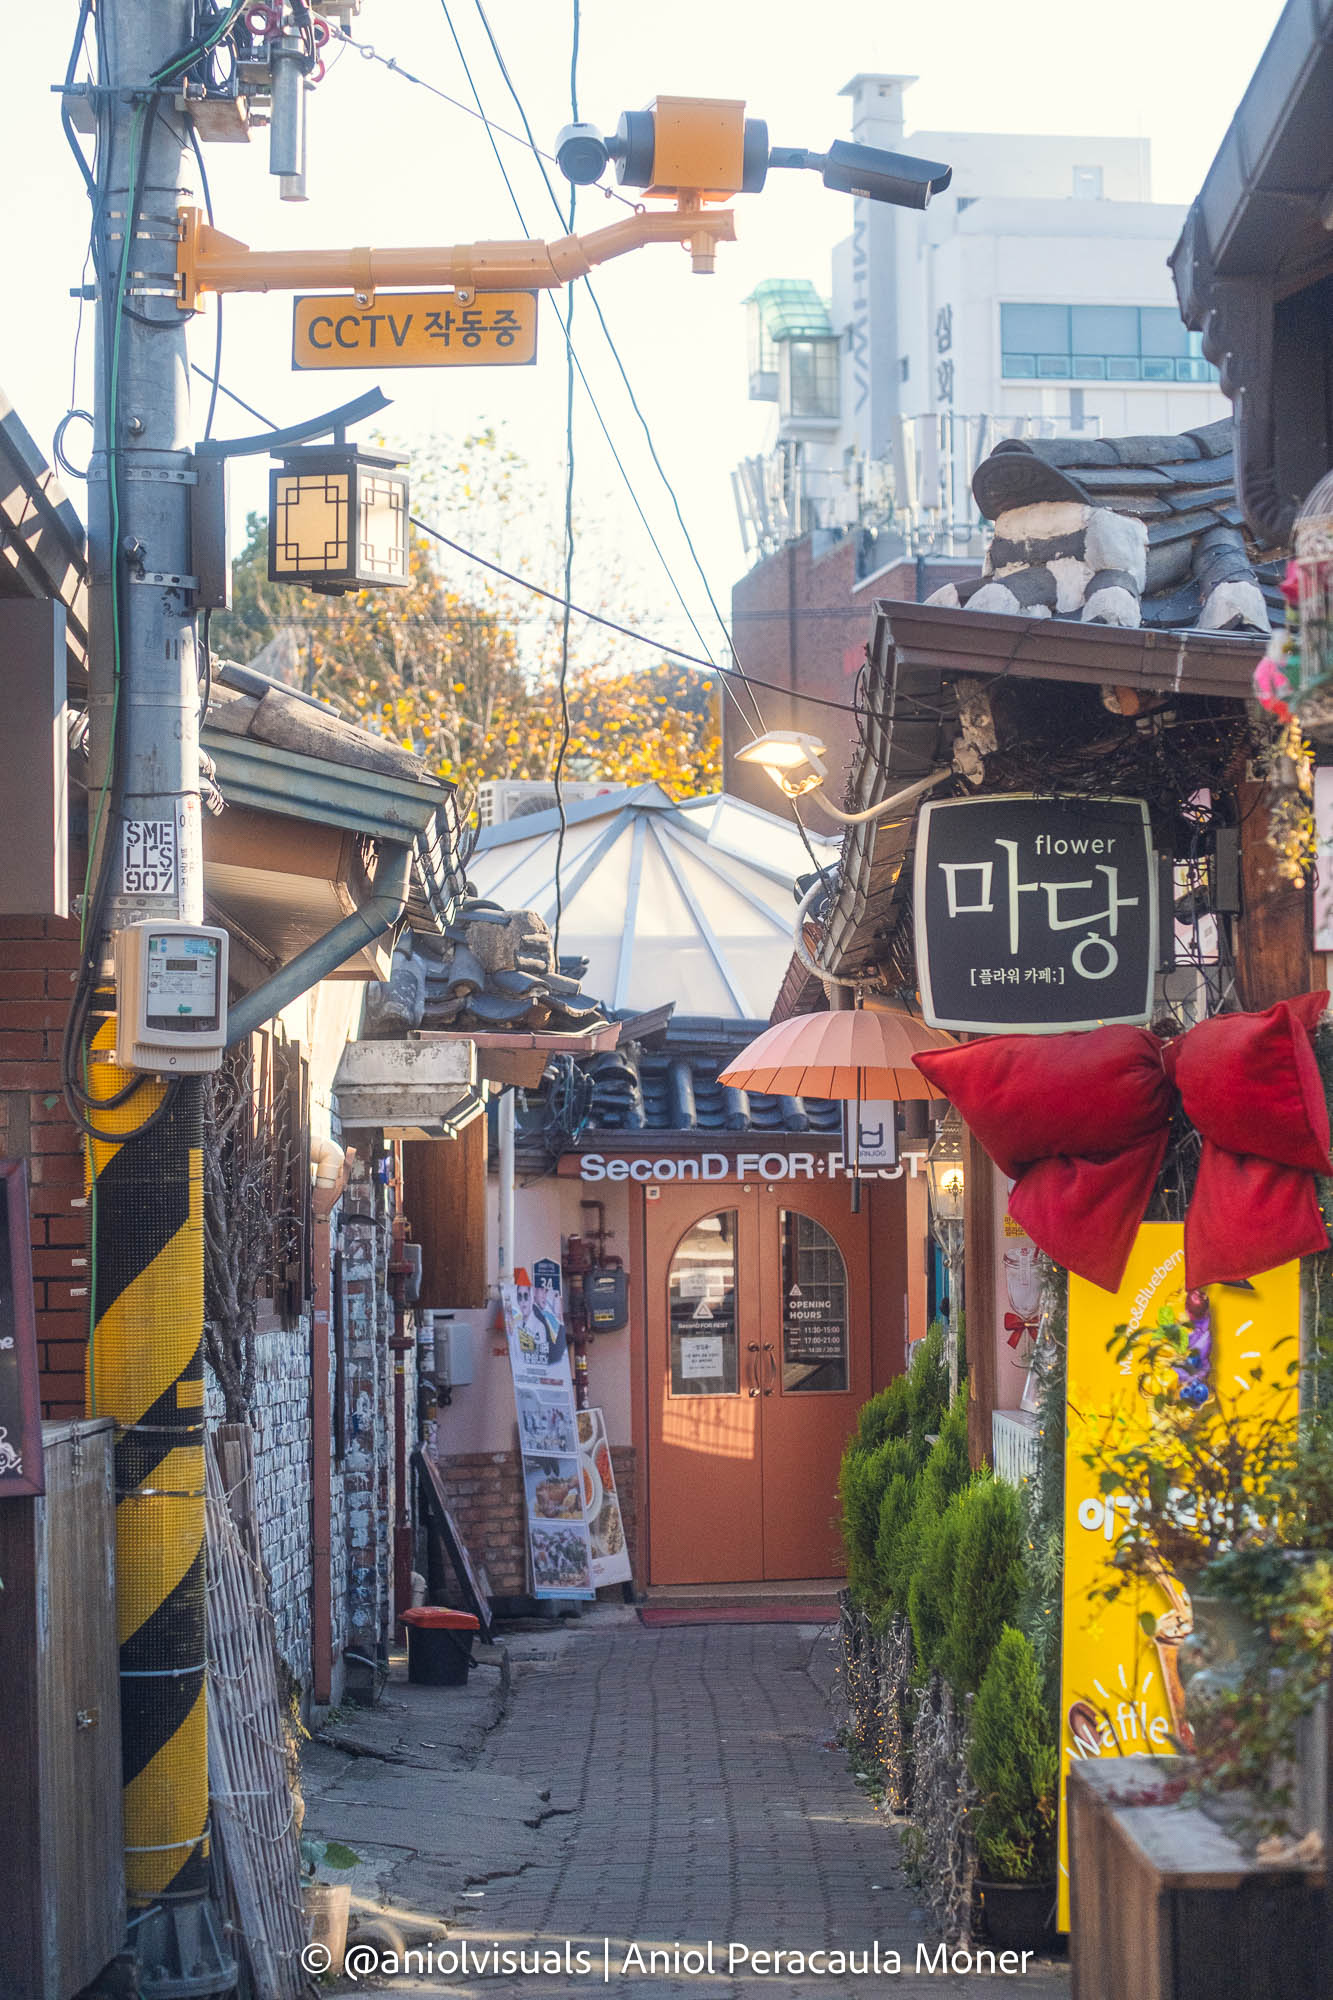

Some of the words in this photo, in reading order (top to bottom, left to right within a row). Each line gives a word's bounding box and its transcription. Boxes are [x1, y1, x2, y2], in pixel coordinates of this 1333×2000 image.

[308, 313, 413, 349] CCTV
[423, 309, 522, 348] 작동중
[1034, 834, 1117, 856] flower
[125, 871, 173, 892] 907
[937, 838, 1140, 980] 마당
[580, 1151, 730, 1182] SeconD
[789, 1300, 832, 1310] OPENING
[789, 1311, 822, 1320] HOURS
[1065, 1700, 1170, 1760] Waffle
